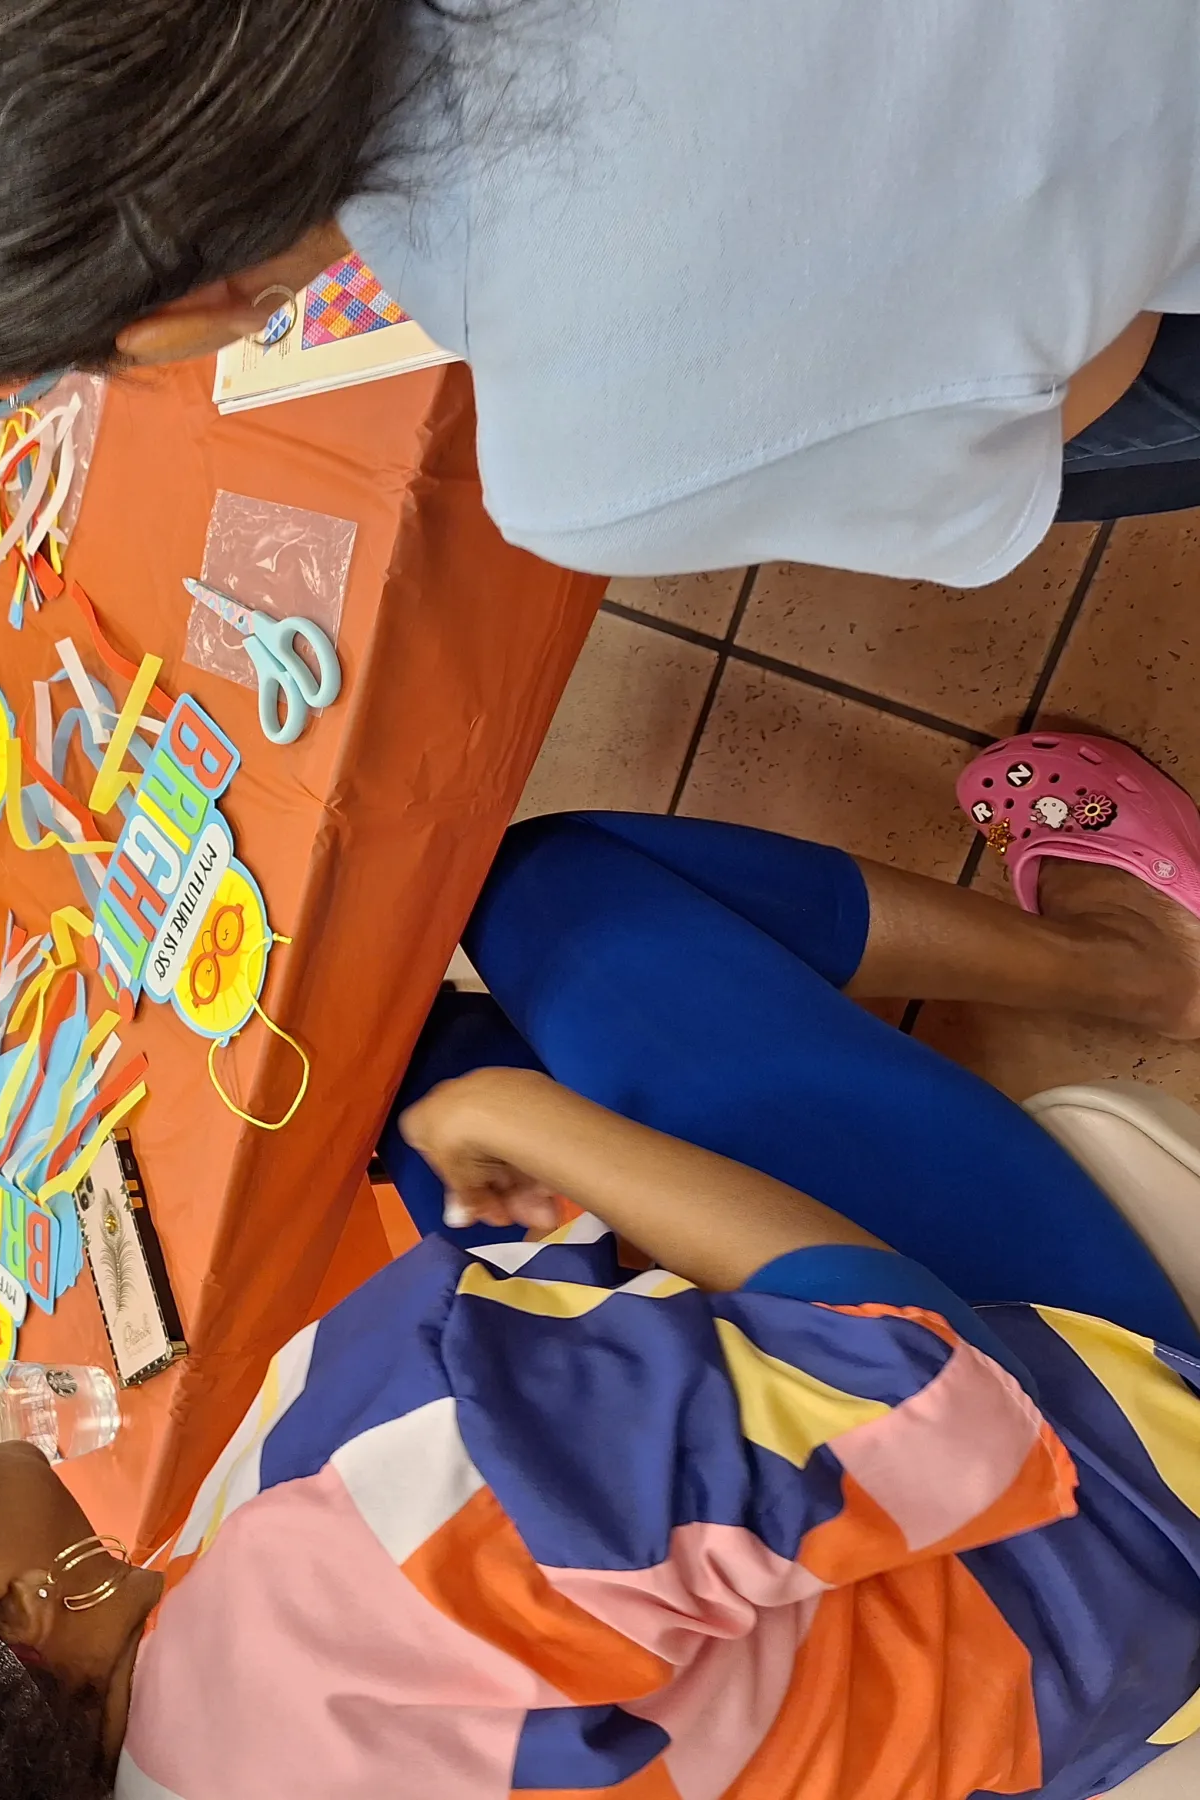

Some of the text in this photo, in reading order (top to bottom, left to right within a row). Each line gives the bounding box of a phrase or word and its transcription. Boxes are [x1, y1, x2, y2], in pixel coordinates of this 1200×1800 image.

[94, 703, 234, 987] BRIGHT!
[973, 802, 993, 822] R
[153, 843, 218, 982] MY FUTURE IS SO
